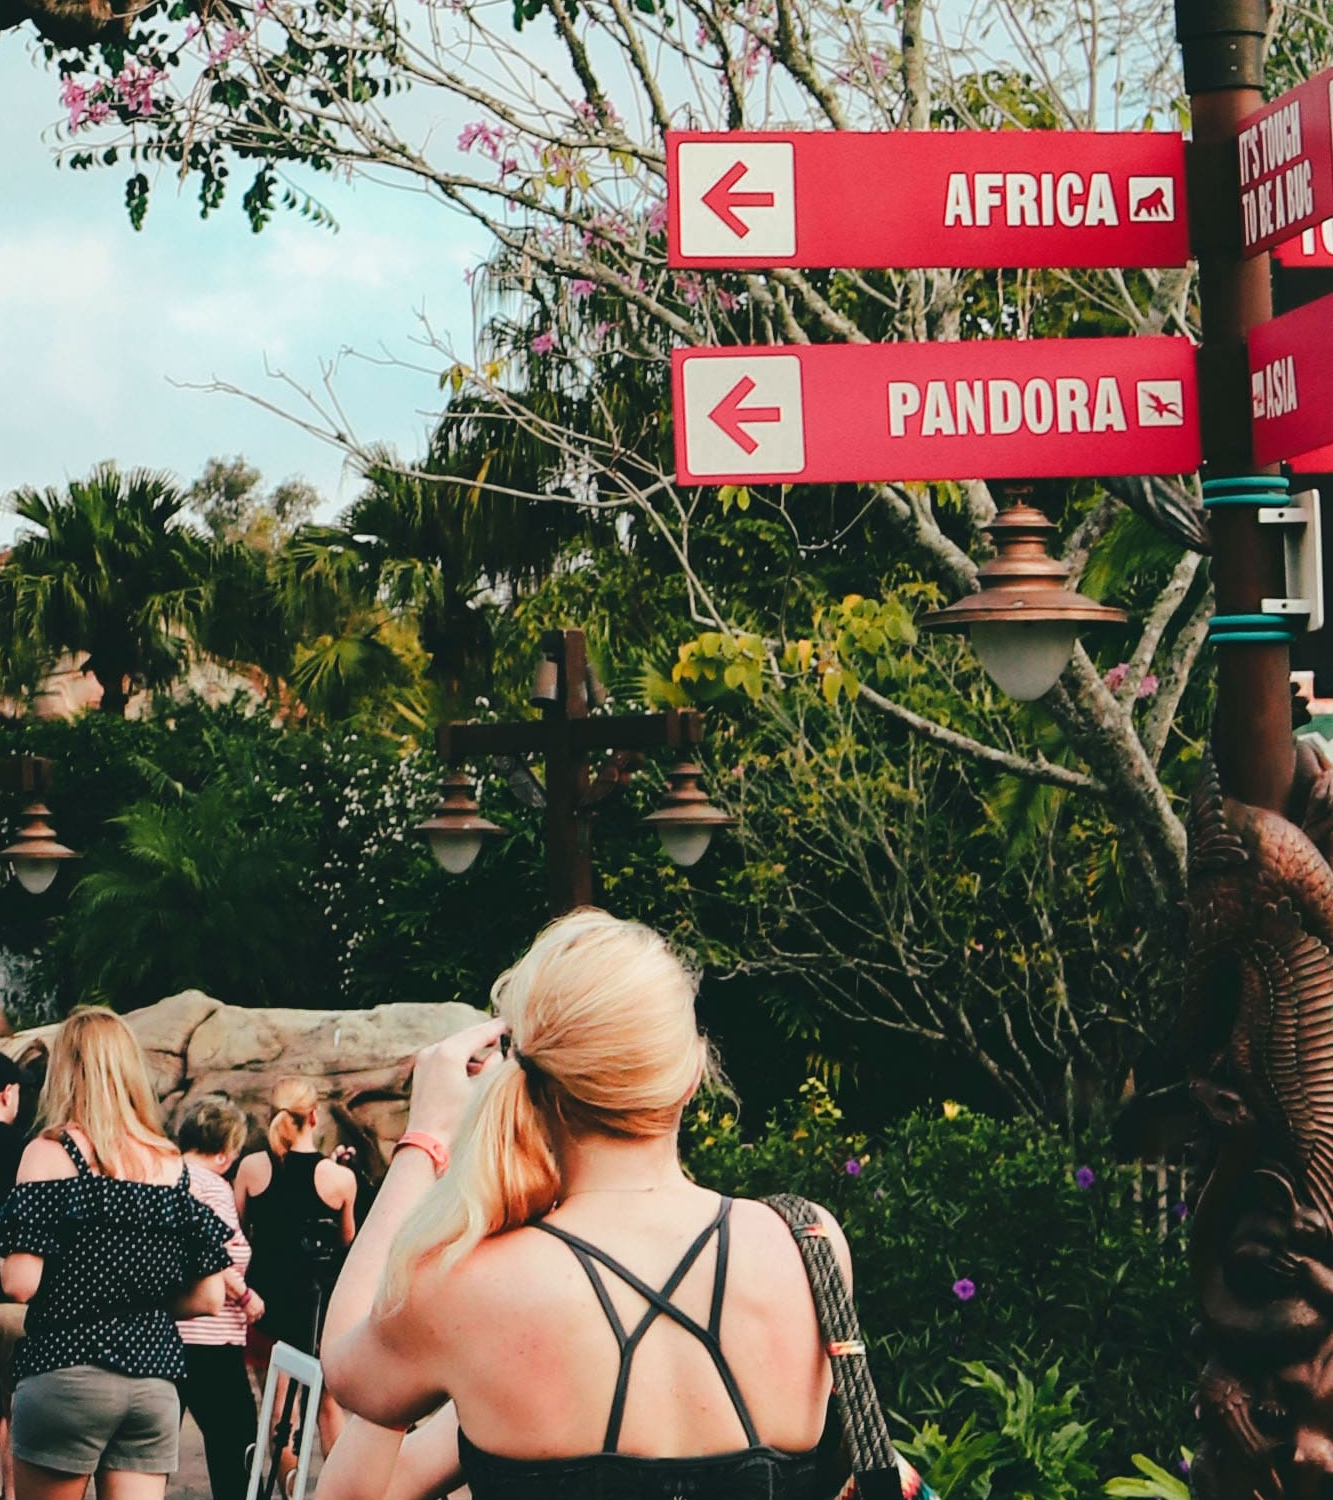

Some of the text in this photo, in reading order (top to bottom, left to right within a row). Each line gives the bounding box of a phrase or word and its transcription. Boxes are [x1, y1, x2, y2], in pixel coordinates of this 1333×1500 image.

[1238, 100, 1301, 187] IT'S TOUGH
[944, 173, 1119, 227] AFRICA
[1241, 188, 1257, 247] TO
[1258, 179, 1274, 239] BE
[1275, 174, 1286, 230] A
[1286, 159, 1314, 225] BUG
[888, 377, 1128, 437] PANDORA
[1265, 355, 1298, 420] ASIA
